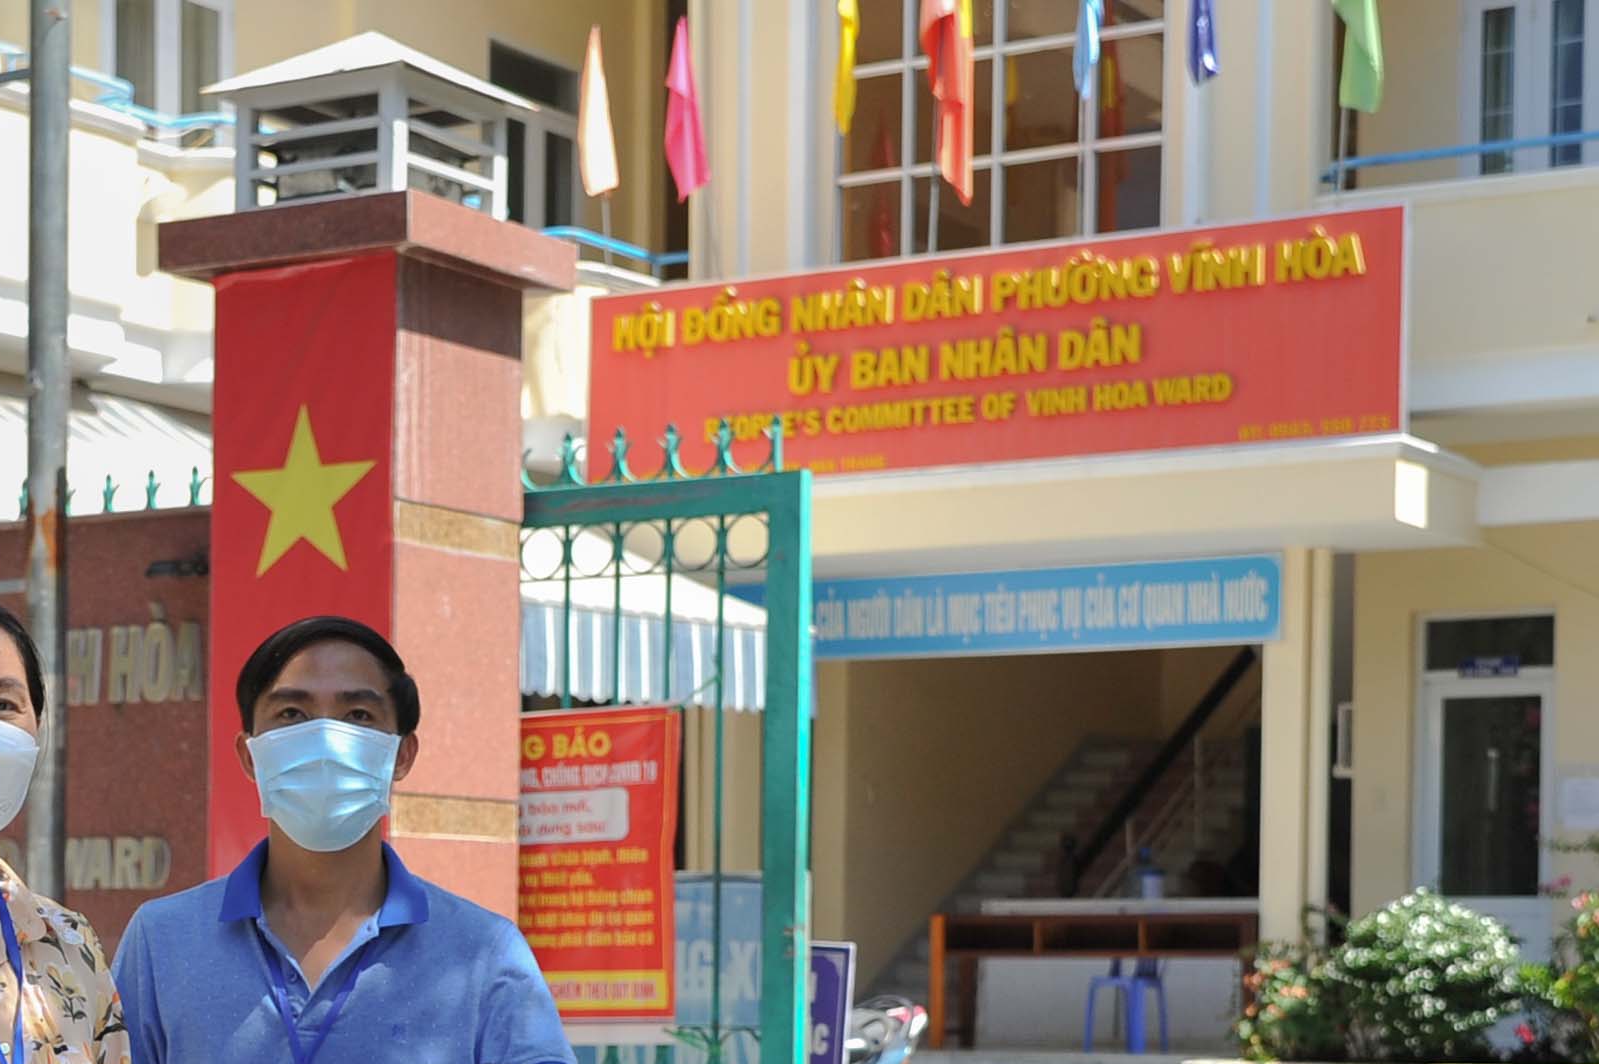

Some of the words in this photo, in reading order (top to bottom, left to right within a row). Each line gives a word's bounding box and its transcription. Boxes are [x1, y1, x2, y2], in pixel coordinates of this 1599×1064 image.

[613, 300, 675, 358] HỘI
[682, 286, 781, 346] ĐỒNG
[791, 277, 895, 333] NHÂN
[904, 268, 983, 320] DÂN
[992, 249, 1160, 312] PHƯỜNG
[1167, 239, 1266, 293] VĨNH
[1275, 224, 1366, 283] HÒA
[787, 341, 840, 395] ỦY
[850, 348, 930, 391] BAN
[940, 325, 1048, 381] NHÂN
[1058, 316, 1142, 371] DÂN
[825, 398, 975, 434] COMMITTEE
[981, 391, 1017, 421] OF
[1025, 384, 1087, 418] VINH
[1093, 381, 1149, 412] HOA
[1153, 373, 1234, 407] WARD
[109, 600, 208, 704] HÒA
[552, 725, 612, 759] BÁO
